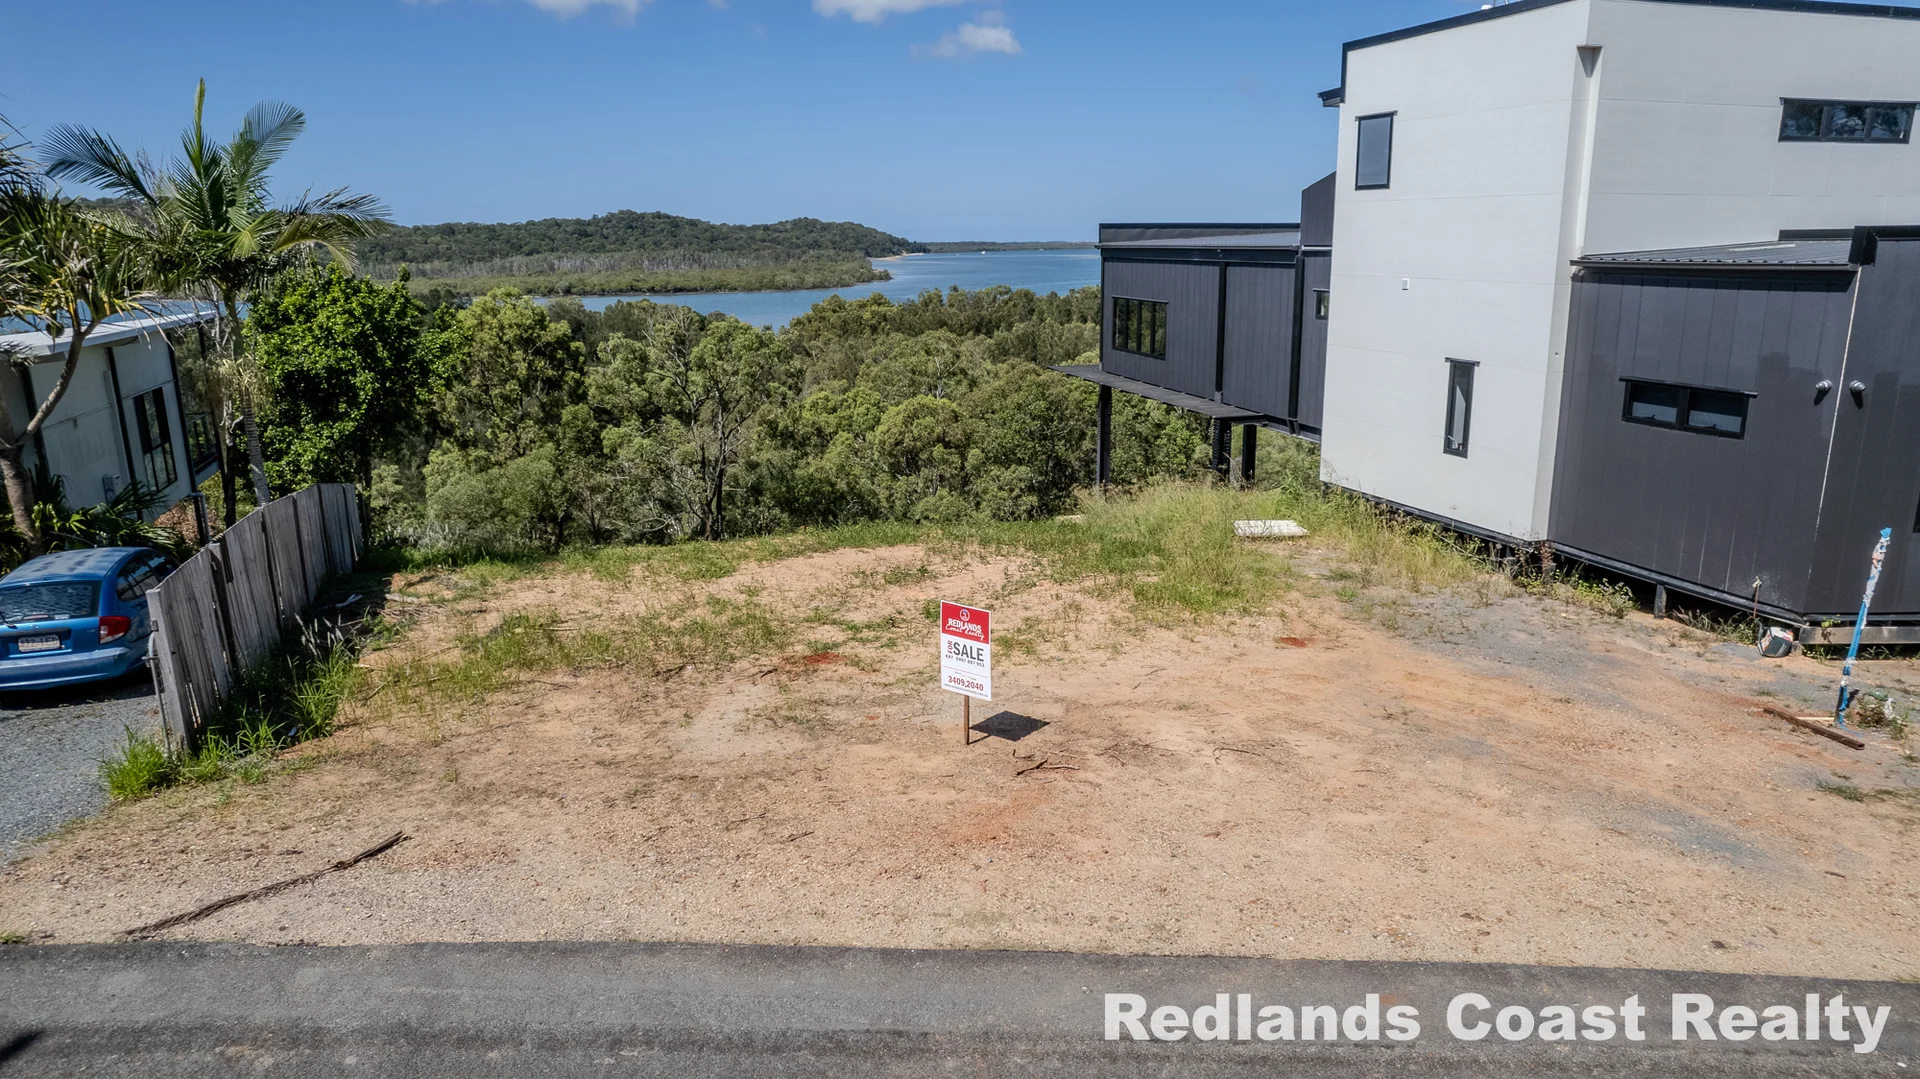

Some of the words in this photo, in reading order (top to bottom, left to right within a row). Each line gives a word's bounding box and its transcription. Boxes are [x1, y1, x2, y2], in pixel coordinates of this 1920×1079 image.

[945, 624, 964, 633] Coast
[964, 626, 985, 641] Realty
[948, 618, 982, 633] REDLANDS
[953, 642, 984, 662] SALE
